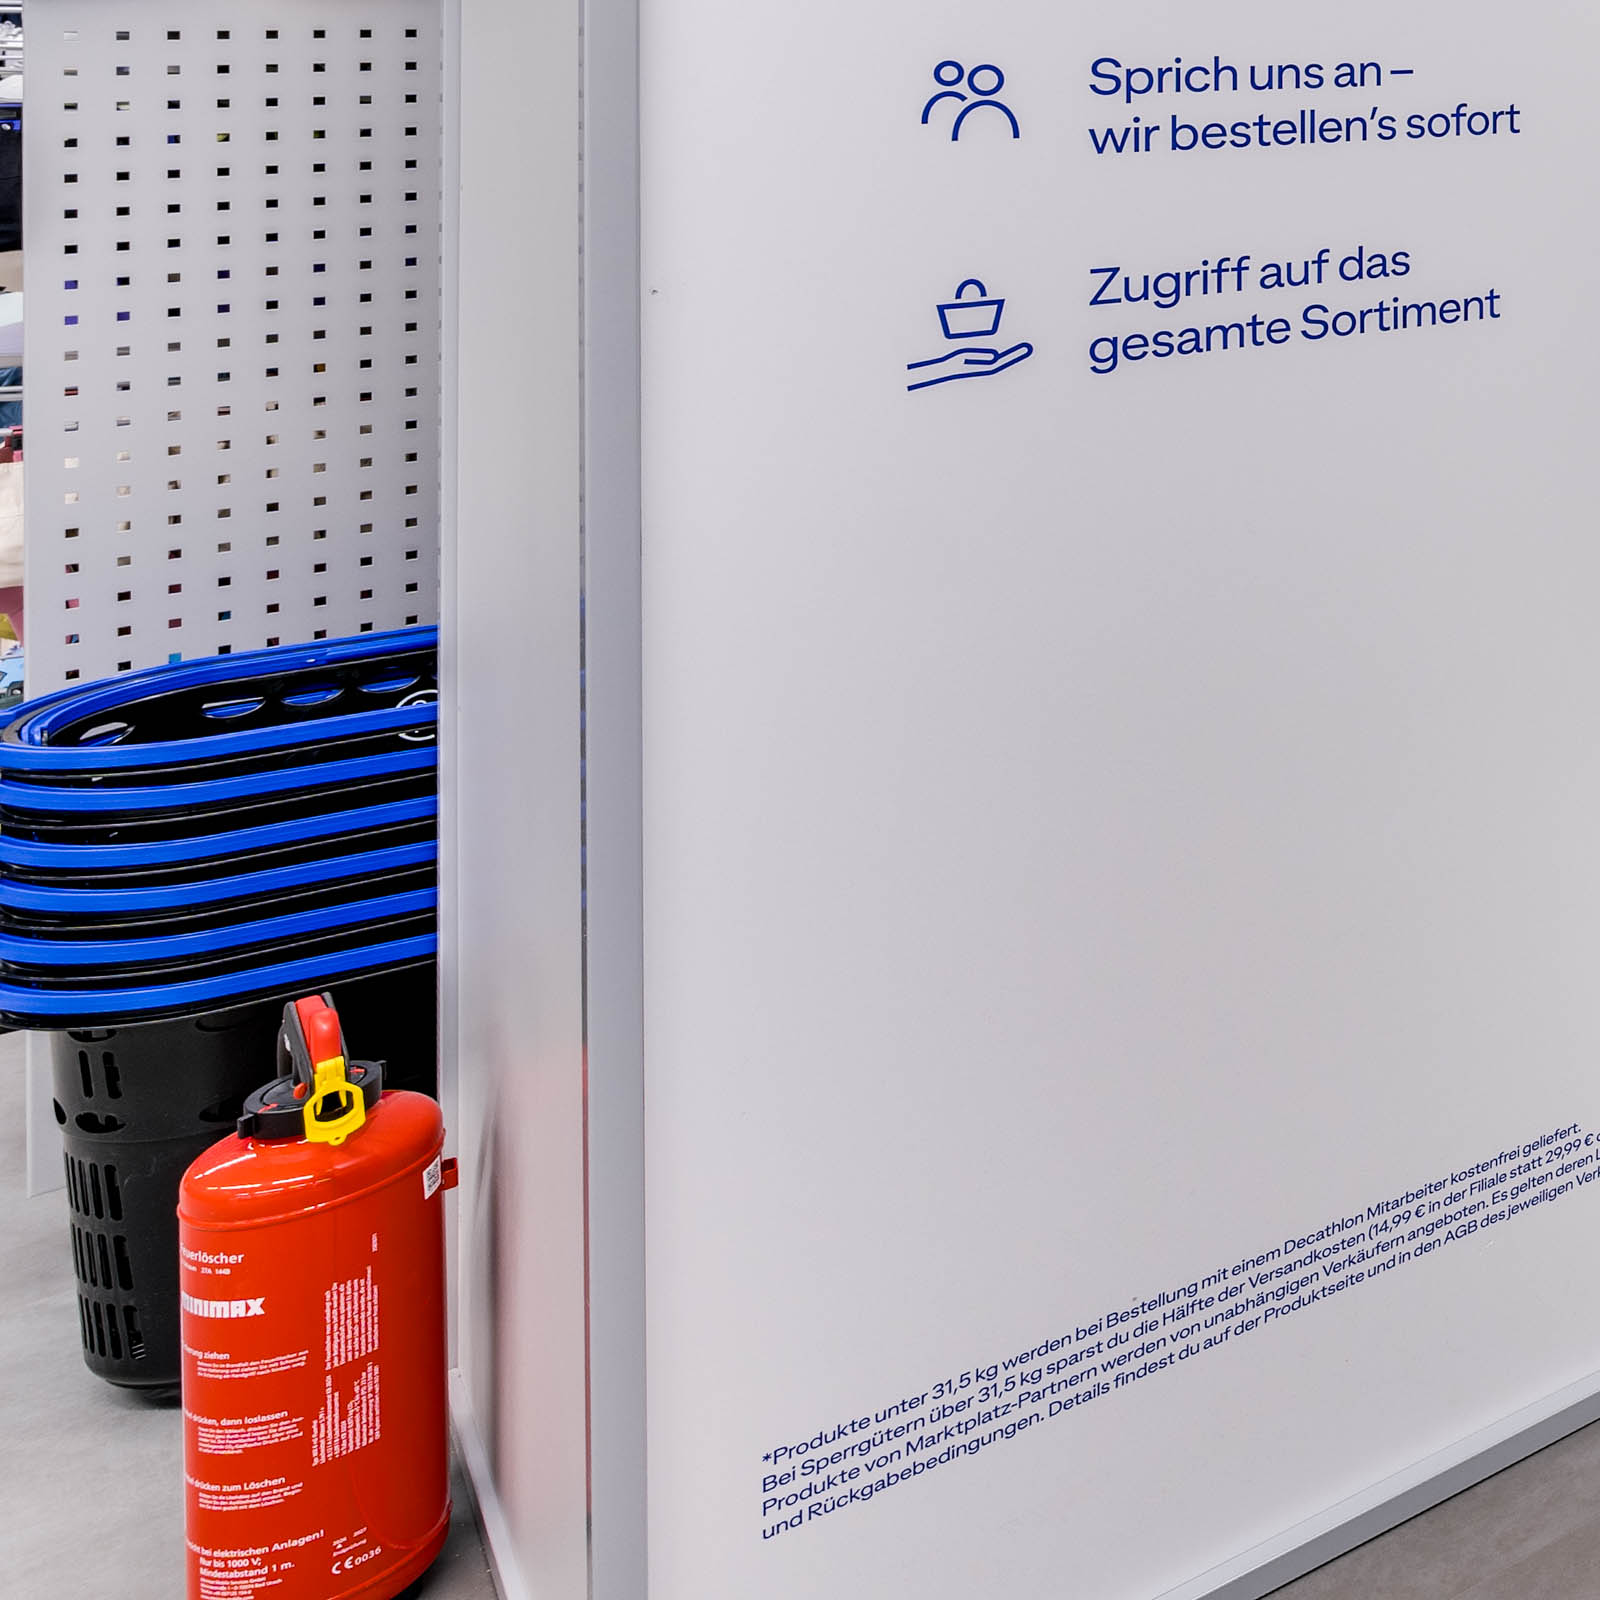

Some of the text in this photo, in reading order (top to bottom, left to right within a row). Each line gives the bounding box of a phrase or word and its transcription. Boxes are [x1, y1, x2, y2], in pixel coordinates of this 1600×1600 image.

[1088, 56, 1237, 103] Sprich
[1250, 64, 1324, 90] uns
[1334, 62, 1381, 88] an
[1088, 103, 1520, 154] wir bestellen’s sofort
[1088, 246, 1410, 308] Zugriff auf das
[1088, 289, 1500, 374] gesamte Sortiment
[874, 1392, 928, 1424] unter
[931, 1371, 971, 1400] 31,5
[975, 1364, 998, 1383] kg
[1001, 1334, 1071, 1372] werden
[1075, 1317, 1102, 1342] bei
[1106, 1281, 1198, 1329] Bestellung
[1201, 1267, 1228, 1290] mit
[1231, 1248, 1280, 1277] einem
[1283, 1213, 1363, 1256] Decathlon
[1366, 1177, 1448, 1221] Mitarbeiter
[1450, 1145, 1520, 1186] kostenfrei
[1522, 1122, 1581, 1158] geliefert.
[762, 1465, 795, 1494] Bei
[800, 1417, 925, 1477] Sperrgütern
[929, 1387, 974, 1424] über
[977, 1374, 1016, 1403] 31,5
[1019, 1367, 1042, 1387] kg
[1046, 1340, 1103, 1375] sparst
[1106, 1331, 1129, 1350] du
[1132, 1319, 1158, 1339] die
[1162, 1296, 1214, 1327] Hälfte
[1217, 1282, 1245, 1303] der
[1247, 1232, 1365, 1289] Versandkosten
[1368, 1209, 1411, 1241] (14,99
[1414, 1203, 1425, 1219] €
[1428, 1200, 1440, 1214] in
[1443, 1188, 1467, 1207] der
[1469, 1172, 1507, 1197] Filiale
[1509, 1155, 1543, 1179] statt
[1545, 1138, 1581, 1165] 29,99
[1583, 1132, 1593, 1147] €
[762, 1466, 860, 1517] Produkte
[863, 1449, 901, 1473] von
[905, 1366, 1097, 1457] Marktplatz-Partnern
[1100, 1337, 1166, 1373] werden
[1169, 1322, 1200, 1343] von
[1204, 1271, 1319, 1329] unabhängigen
[1322, 1234, 1404, 1277] Verkäufern
[1407, 1200, 1488, 1242] angeboten.
[1491, 1189, 1508, 1206] Es
[1510, 1171, 1553, 1200] gelten
[1555, 1154, 1593, 1178] deren
[203, 1351, 230, 1360] ziehen
[762, 1508, 802, 1540] und
[807, 1412, 1044, 1521] Rückgabebedingungen.
[1048, 1382, 1110, 1418] Details
[1112, 1351, 1175, 1389] findest
[1178, 1342, 1200, 1361] du
[1202, 1325, 1231, 1351] auf
[1233, 1315, 1261, 1336] der
[1264, 1271, 1364, 1324] Produktseite
[1367, 1254, 1395, 1278] und
[1398, 1251, 1410, 1265] in
[1413, 1238, 1441, 1258] den
[1443, 1219, 1477, 1245] AGB
[1480, 1210, 1505, 1229] des
[1505, 1180, 1573, 1221] jeweiligen
[220, 1417, 242, 1426] dann
[244, 1411, 288, 1424] loslassen
[244, 1477, 286, 1490] Löschen
[200, 1556, 212, 1566] Nur
[213, 1558, 225, 1568] bis
[227, 1558, 249, 1568] 1000
[201, 1546, 212, 1556] bei
[213, 1545, 269, 1558] elektrischen
[271, 1529, 325, 1552] Anlagen!
[354, 1545, 382, 1565] 0036
[200, 1565, 268, 1578] Mindestabstand
[280, 1562, 295, 1571] m.
